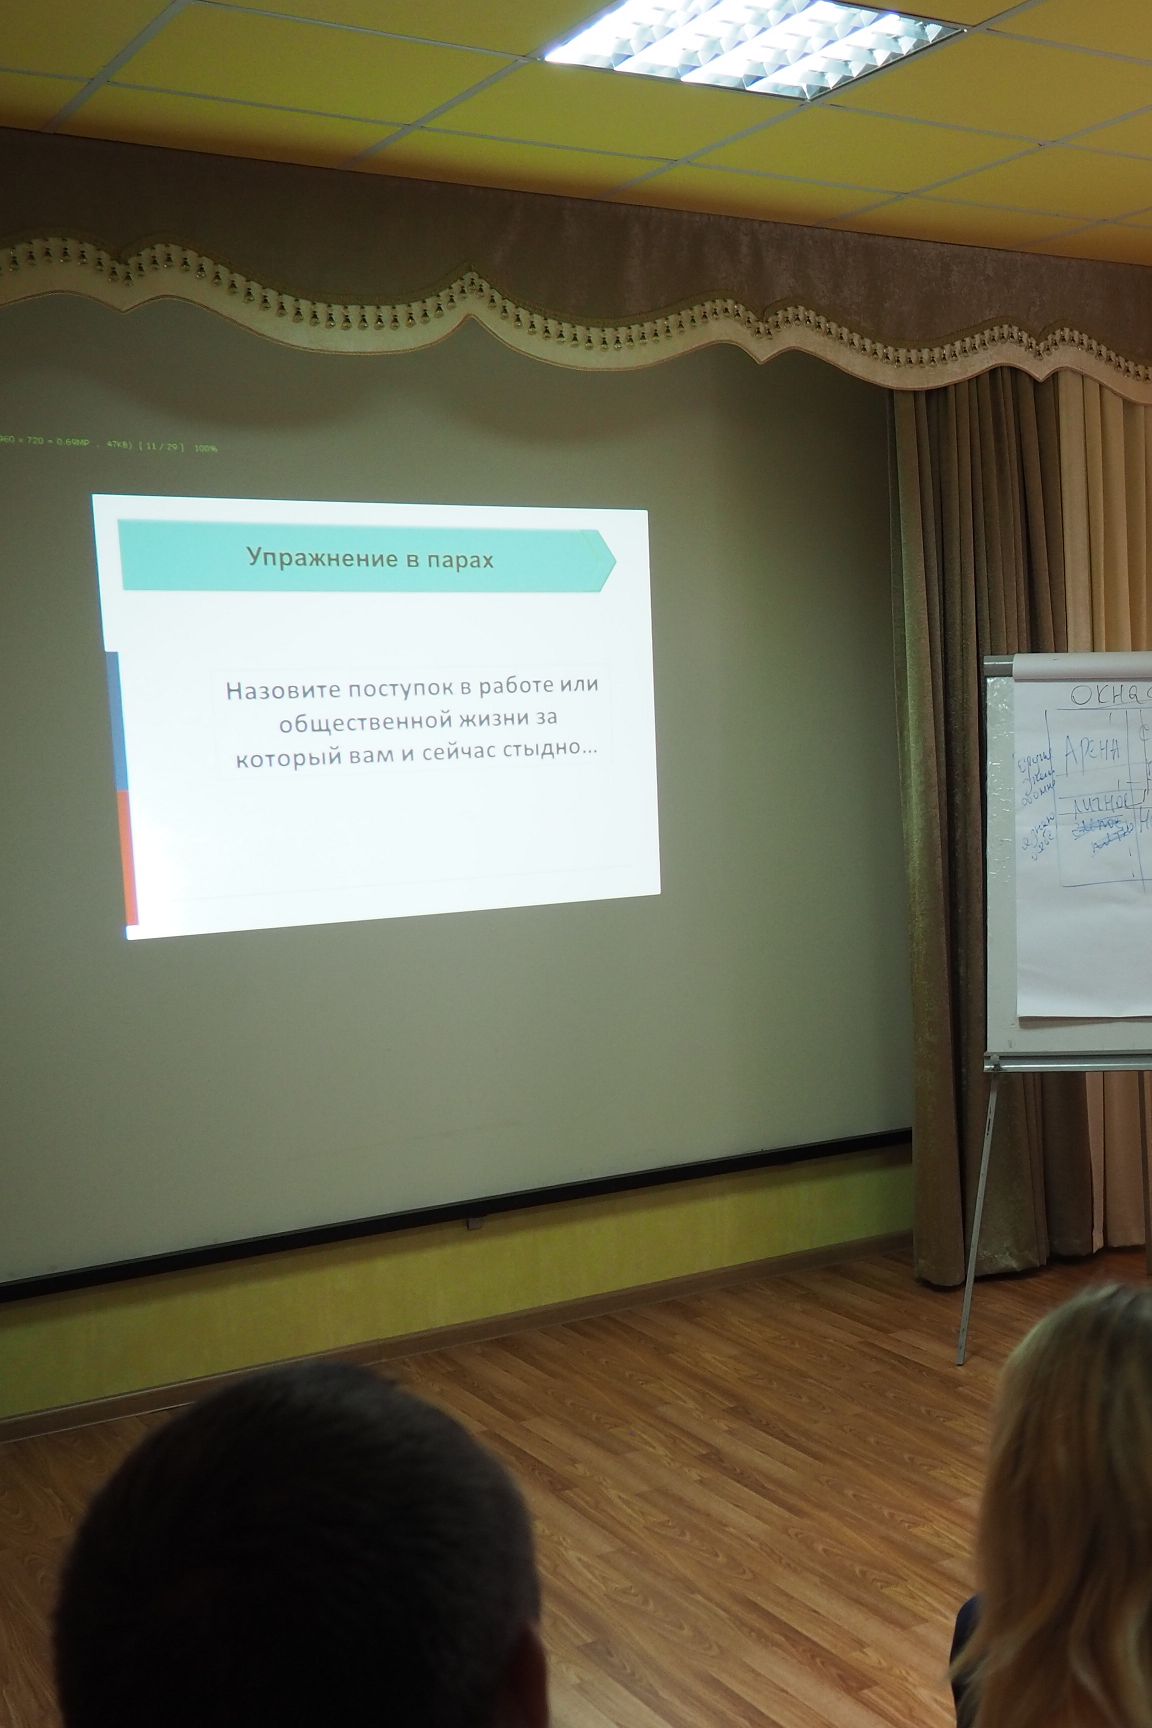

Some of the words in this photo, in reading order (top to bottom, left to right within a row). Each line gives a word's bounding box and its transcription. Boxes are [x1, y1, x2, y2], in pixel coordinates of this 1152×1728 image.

[246, 546, 399, 571] Упражнение
[406, 550, 420, 568] в
[427, 553, 495, 573] парах
[226, 681, 342, 701] Назовите
[348, 680, 454, 702] поступок
[460, 680, 472, 695] в
[479, 674, 554, 699] работе
[560, 678, 599, 693] или
[279, 709, 453, 737] общественной
[459, 712, 530, 728] жизни
[536, 710, 558, 726] за
[236, 745, 342, 772] который
[349, 749, 395, 765] вам
[401, 747, 415, 763] и
[422, 741, 496, 761] сейчас
[502, 740, 598, 760] стыдно...
